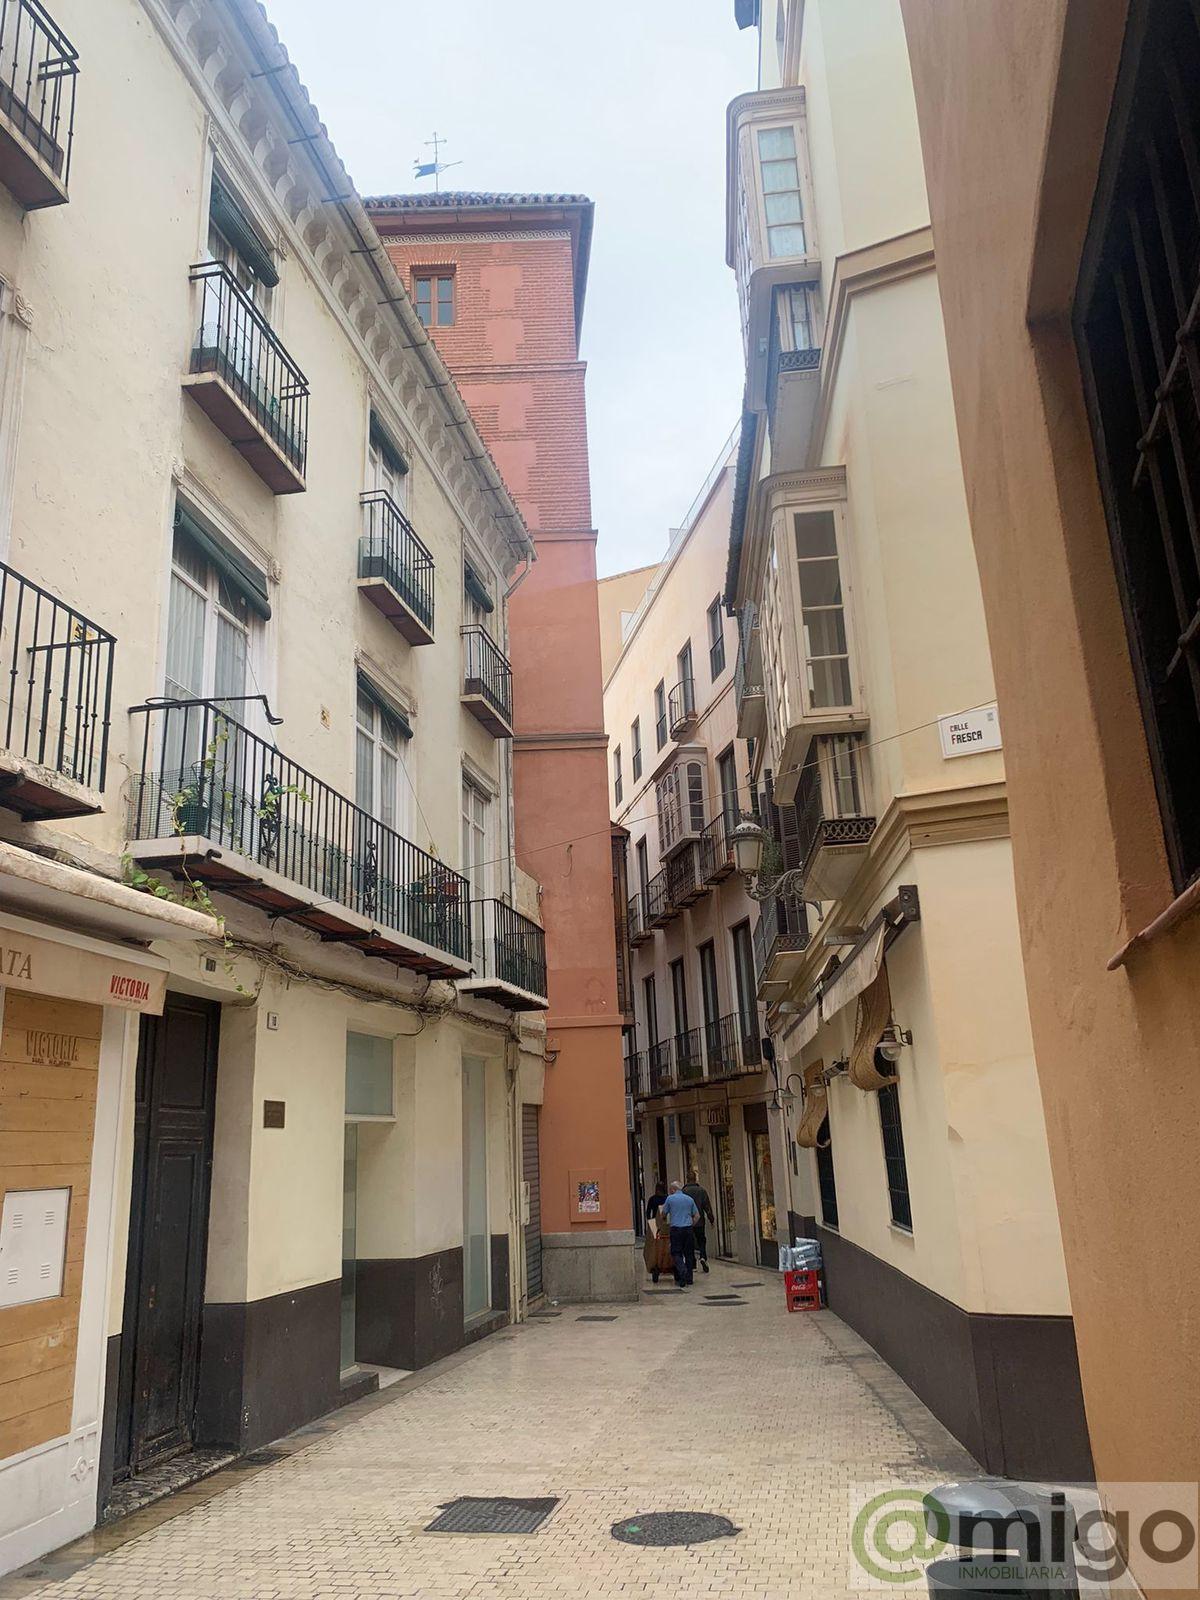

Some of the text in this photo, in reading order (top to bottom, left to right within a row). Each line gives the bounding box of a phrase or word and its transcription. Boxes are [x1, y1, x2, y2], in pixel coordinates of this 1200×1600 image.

[950, 722, 969, 732] CALLE
[951, 730, 983, 745] FRESCA
[110, 975, 150, 1000] VICTORIA
[26, 1029, 78, 1061] VICTORIA
